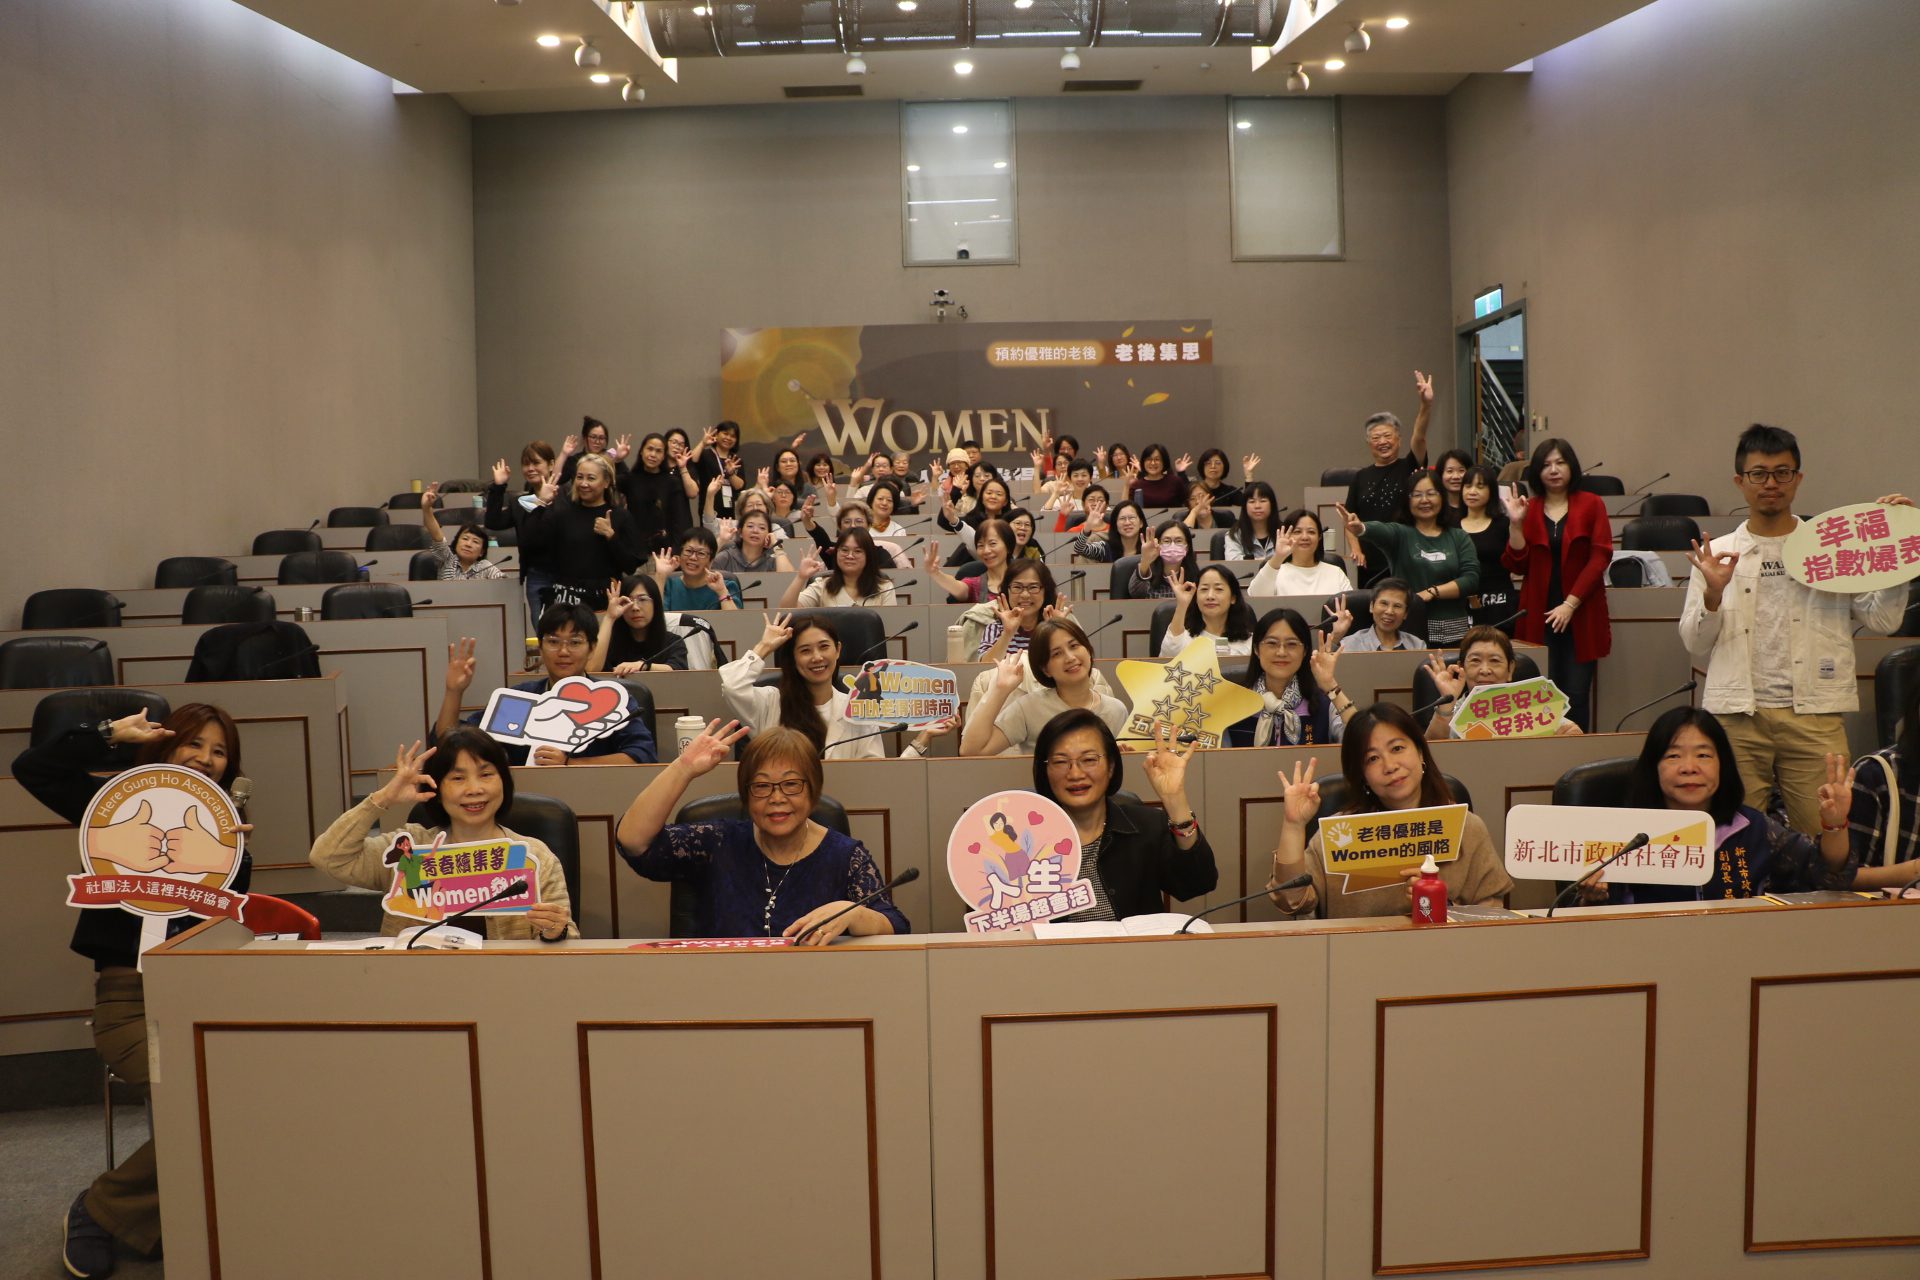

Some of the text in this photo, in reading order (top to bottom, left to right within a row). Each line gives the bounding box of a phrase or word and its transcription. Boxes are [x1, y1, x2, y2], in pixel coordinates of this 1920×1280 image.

[994, 345, 1097, 362] 預約優雅的老後
[1114, 341, 1201, 363] 老後集思
[810, 398, 1051, 456] WOMEN
[1815, 508, 1891, 548] 幸福
[1802, 535, 1920, 584] 指數爆表
[879, 671, 955, 695] Women
[1469, 690, 1554, 718] 安居安心
[1492, 712, 1555, 736] 安我心
[97, 773, 232, 835] Here Gung Ho Association
[1357, 819, 1444, 843] 老得優雅是
[1331, 838, 1450, 863] Women的風格
[1512, 837, 1706, 869] 新北市政府社會局
[85, 879, 231, 911] 社團法人這裡共好協會
[986, 858, 1063, 910] 人生
[970, 884, 1091, 933] 下半場超會活
